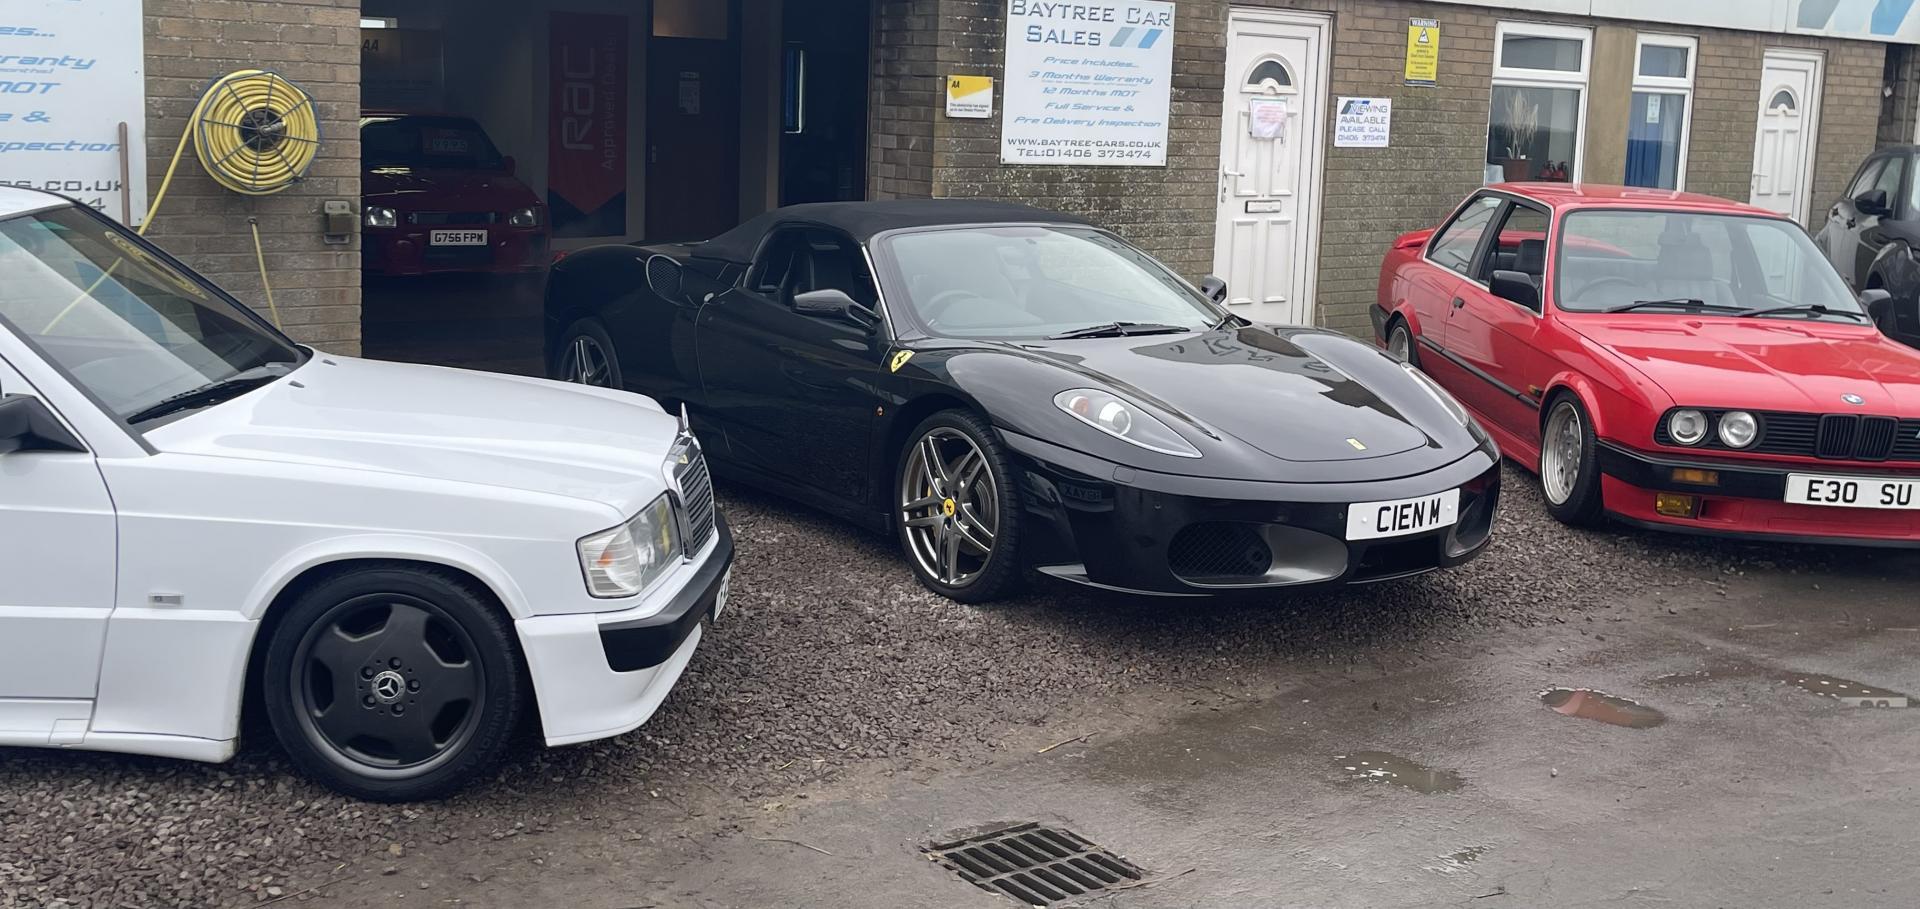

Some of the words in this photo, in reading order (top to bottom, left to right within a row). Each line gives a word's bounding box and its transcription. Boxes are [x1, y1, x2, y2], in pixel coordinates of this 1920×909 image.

[1010, 0, 1115, 22] BAYTREE
[1126, 8, 1171, 27] CAR
[1411, 19, 1438, 28] WARNING
[1027, 25, 1101, 46] SALES
[362, 39, 379, 52] AA
[0, 55, 96, 70] ranty
[1043, 56, 1080, 65] Price
[1042, 71, 1090, 81] Months
[1094, 74, 1154, 85] Warranty
[952, 80, 960, 89] AA
[1059, 87, 1107, 97] Months
[1045, 102, 1070, 110] Full
[1071, 103, 1121, 112] Service
[1351, 103, 1388, 113] VIEWING
[1014, 116, 1041, 124] Pre
[1042, 117, 1096, 128] Delivery
[1098, 119, 1161, 128] Inspection
[1340, 116, 1387, 125] AVAILABLE
[0, 140, 121, 152] pection
[1097, 150, 1152, 159] 373474
[434, 232, 462, 243] G756
[1806, 479, 1858, 504] E30
[1880, 483, 1913, 506] SU
[1429, 497, 1441, 526] M
